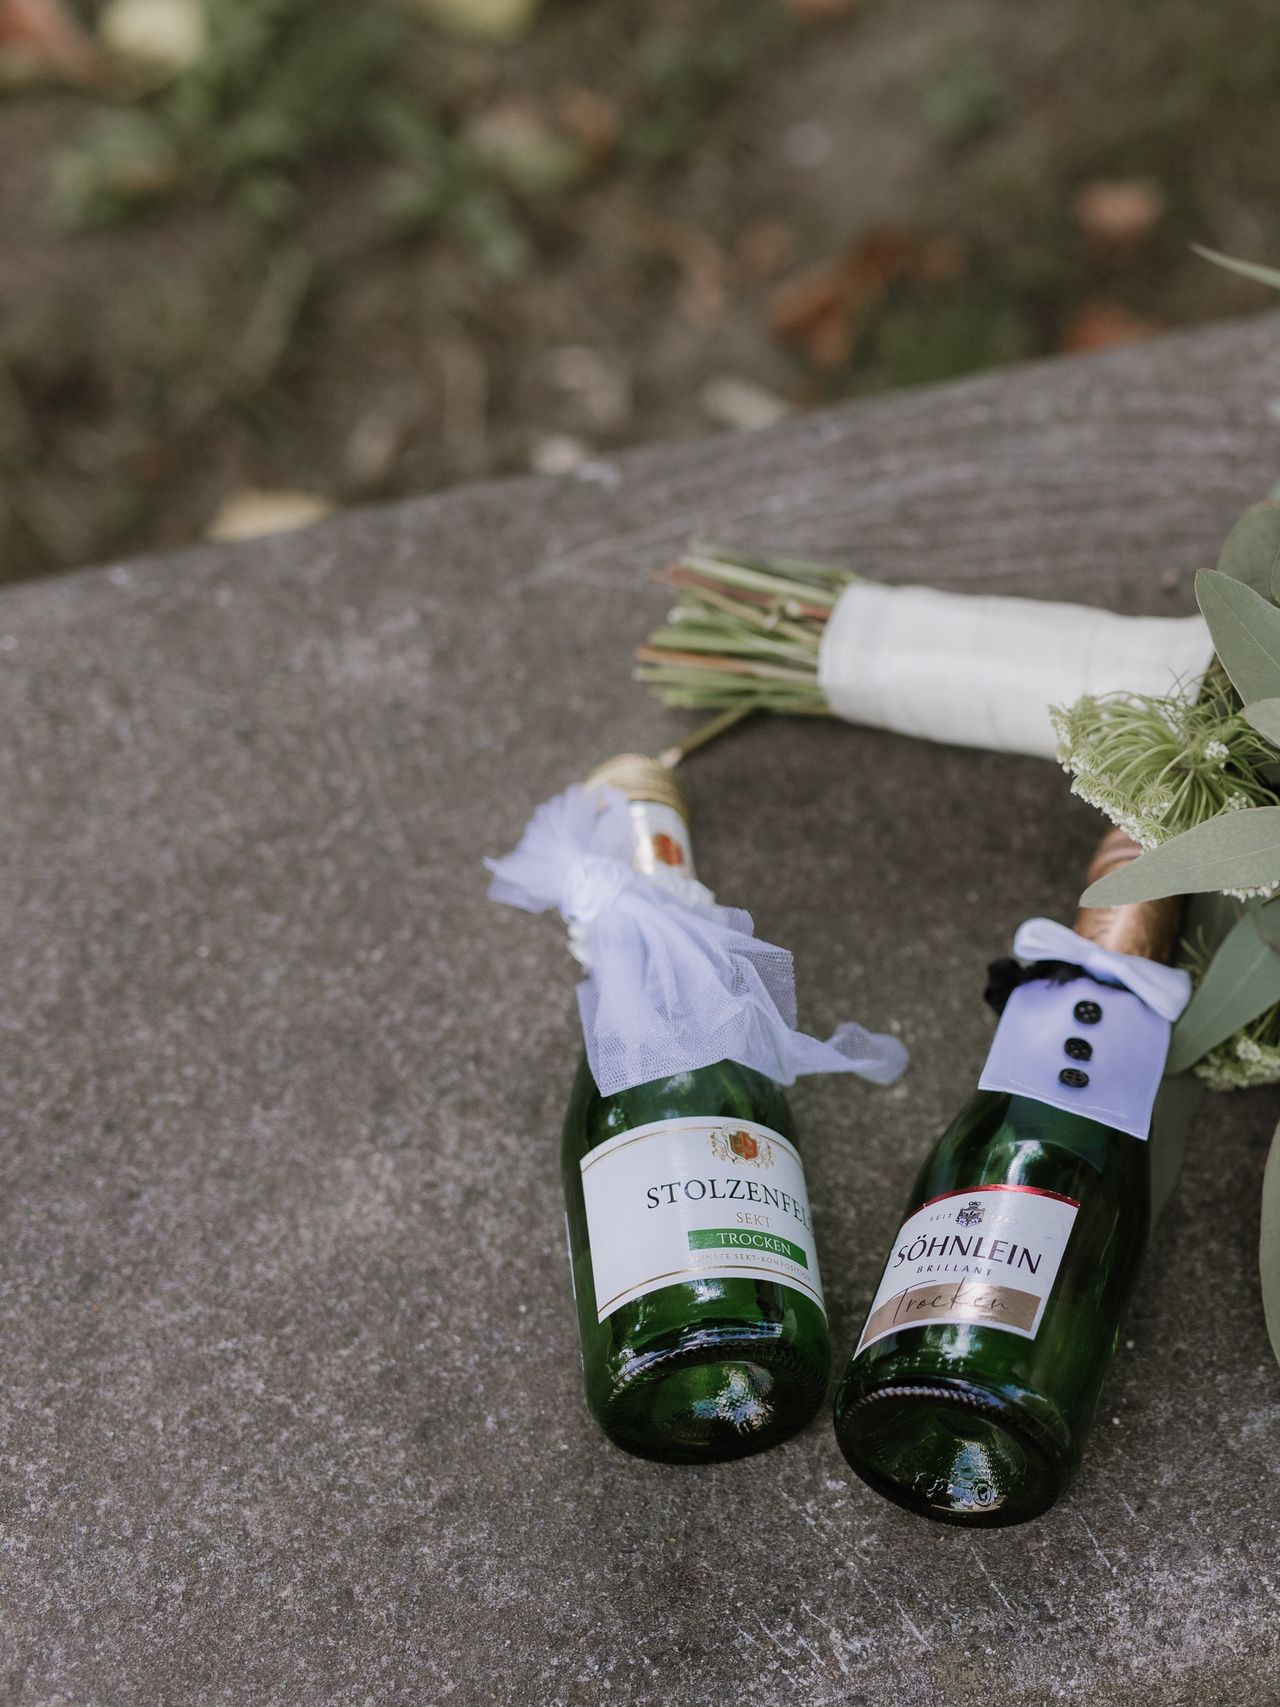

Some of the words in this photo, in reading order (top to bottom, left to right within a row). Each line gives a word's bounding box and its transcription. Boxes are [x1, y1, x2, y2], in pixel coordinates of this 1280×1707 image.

[736, 1212, 772, 1228] SEKT
[929, 1214, 953, 1223] SEIT
[717, 1232, 791, 1255] TROCKEN
[893, 1234, 1042, 1274] SÖHNLEIN
[916, 1265, 994, 1277] BRILLANT
[886, 1277, 1009, 1325] Trocken
